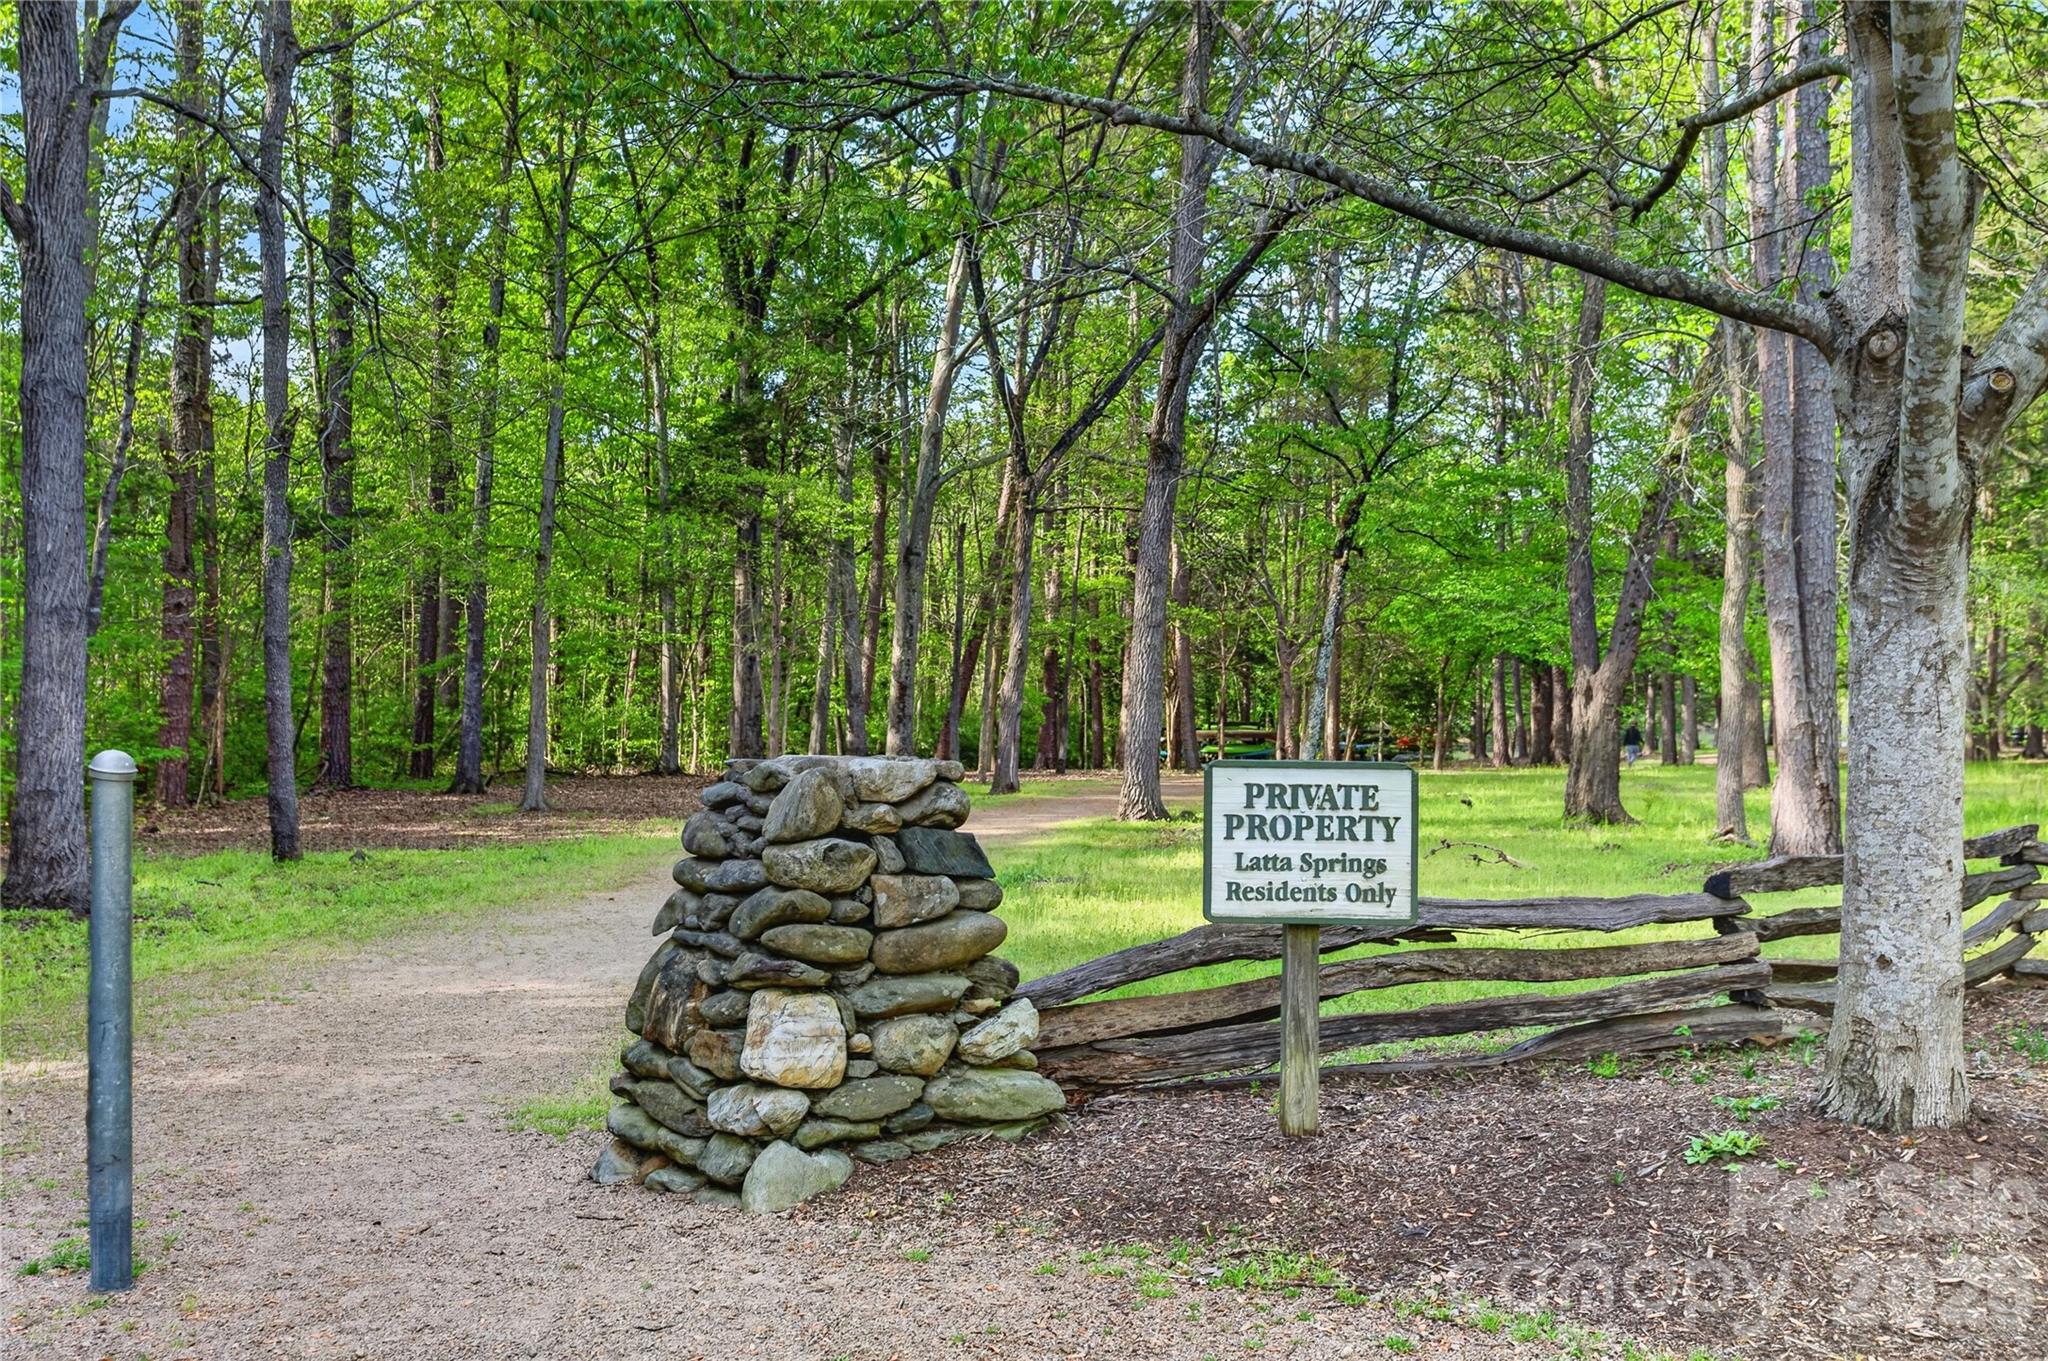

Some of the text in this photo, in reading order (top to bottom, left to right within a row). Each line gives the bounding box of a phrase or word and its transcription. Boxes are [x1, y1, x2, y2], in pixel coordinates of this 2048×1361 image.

[1243, 782, 1380, 811] PRIVATE
[1223, 813, 1401, 842] PROPERTY
[1234, 852, 1388, 879] Latta Springs
[1225, 881, 1396, 908] Residents Only
